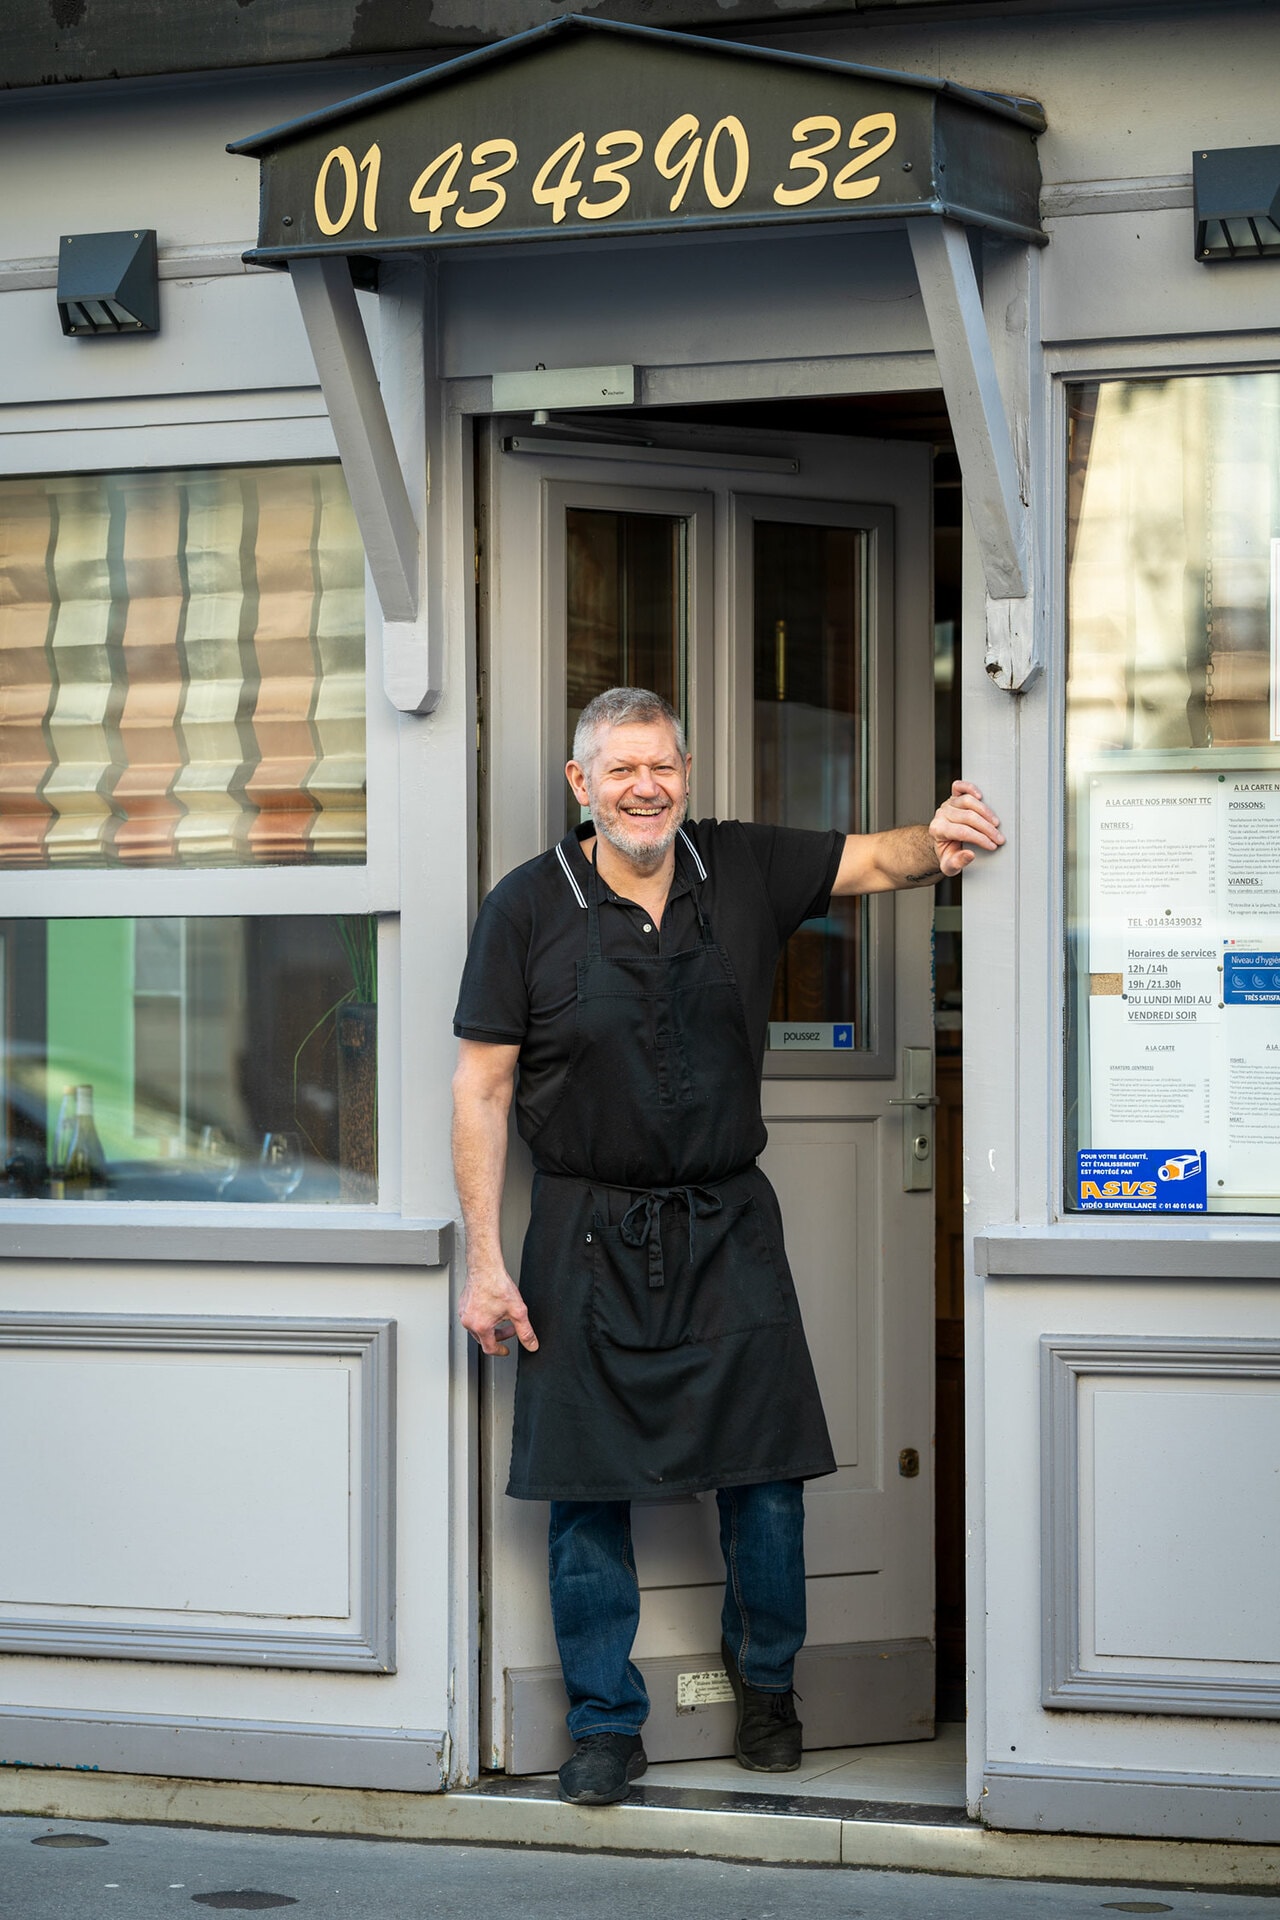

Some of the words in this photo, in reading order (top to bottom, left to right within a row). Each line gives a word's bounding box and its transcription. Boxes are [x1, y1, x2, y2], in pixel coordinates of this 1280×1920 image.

[314, 143, 381, 236] 01
[409, 138, 518, 233] 43
[531, 129, 644, 224] 43
[654, 113, 750, 212] 90
[773, 112, 897, 206] 32
[1127, 918, 1143, 927] TEL
[1127, 949, 1166, 958] Horaires
[1167, 949, 1179, 957] de
[1180, 949, 1217, 957] services
[1231, 955, 1254, 964] Niveau
[1128, 964, 1145, 973] 12h
[1128, 980, 1144, 989] 19h
[1128, 995, 1141, 1004] DU
[1143, 995, 1172, 1004] LUNDI
[1174, 995, 1196, 1004] MIDI
[1198, 995, 1212, 1004] AU
[1128, 1011, 1174, 1020] VENDREDI
[1175, 1011, 1197, 1020] SOIR
[783, 1032, 821, 1044] poussez
[1080, 1180, 1157, 1199] ASVS
[1081, 1201, 1103, 1209] VIDÉO
